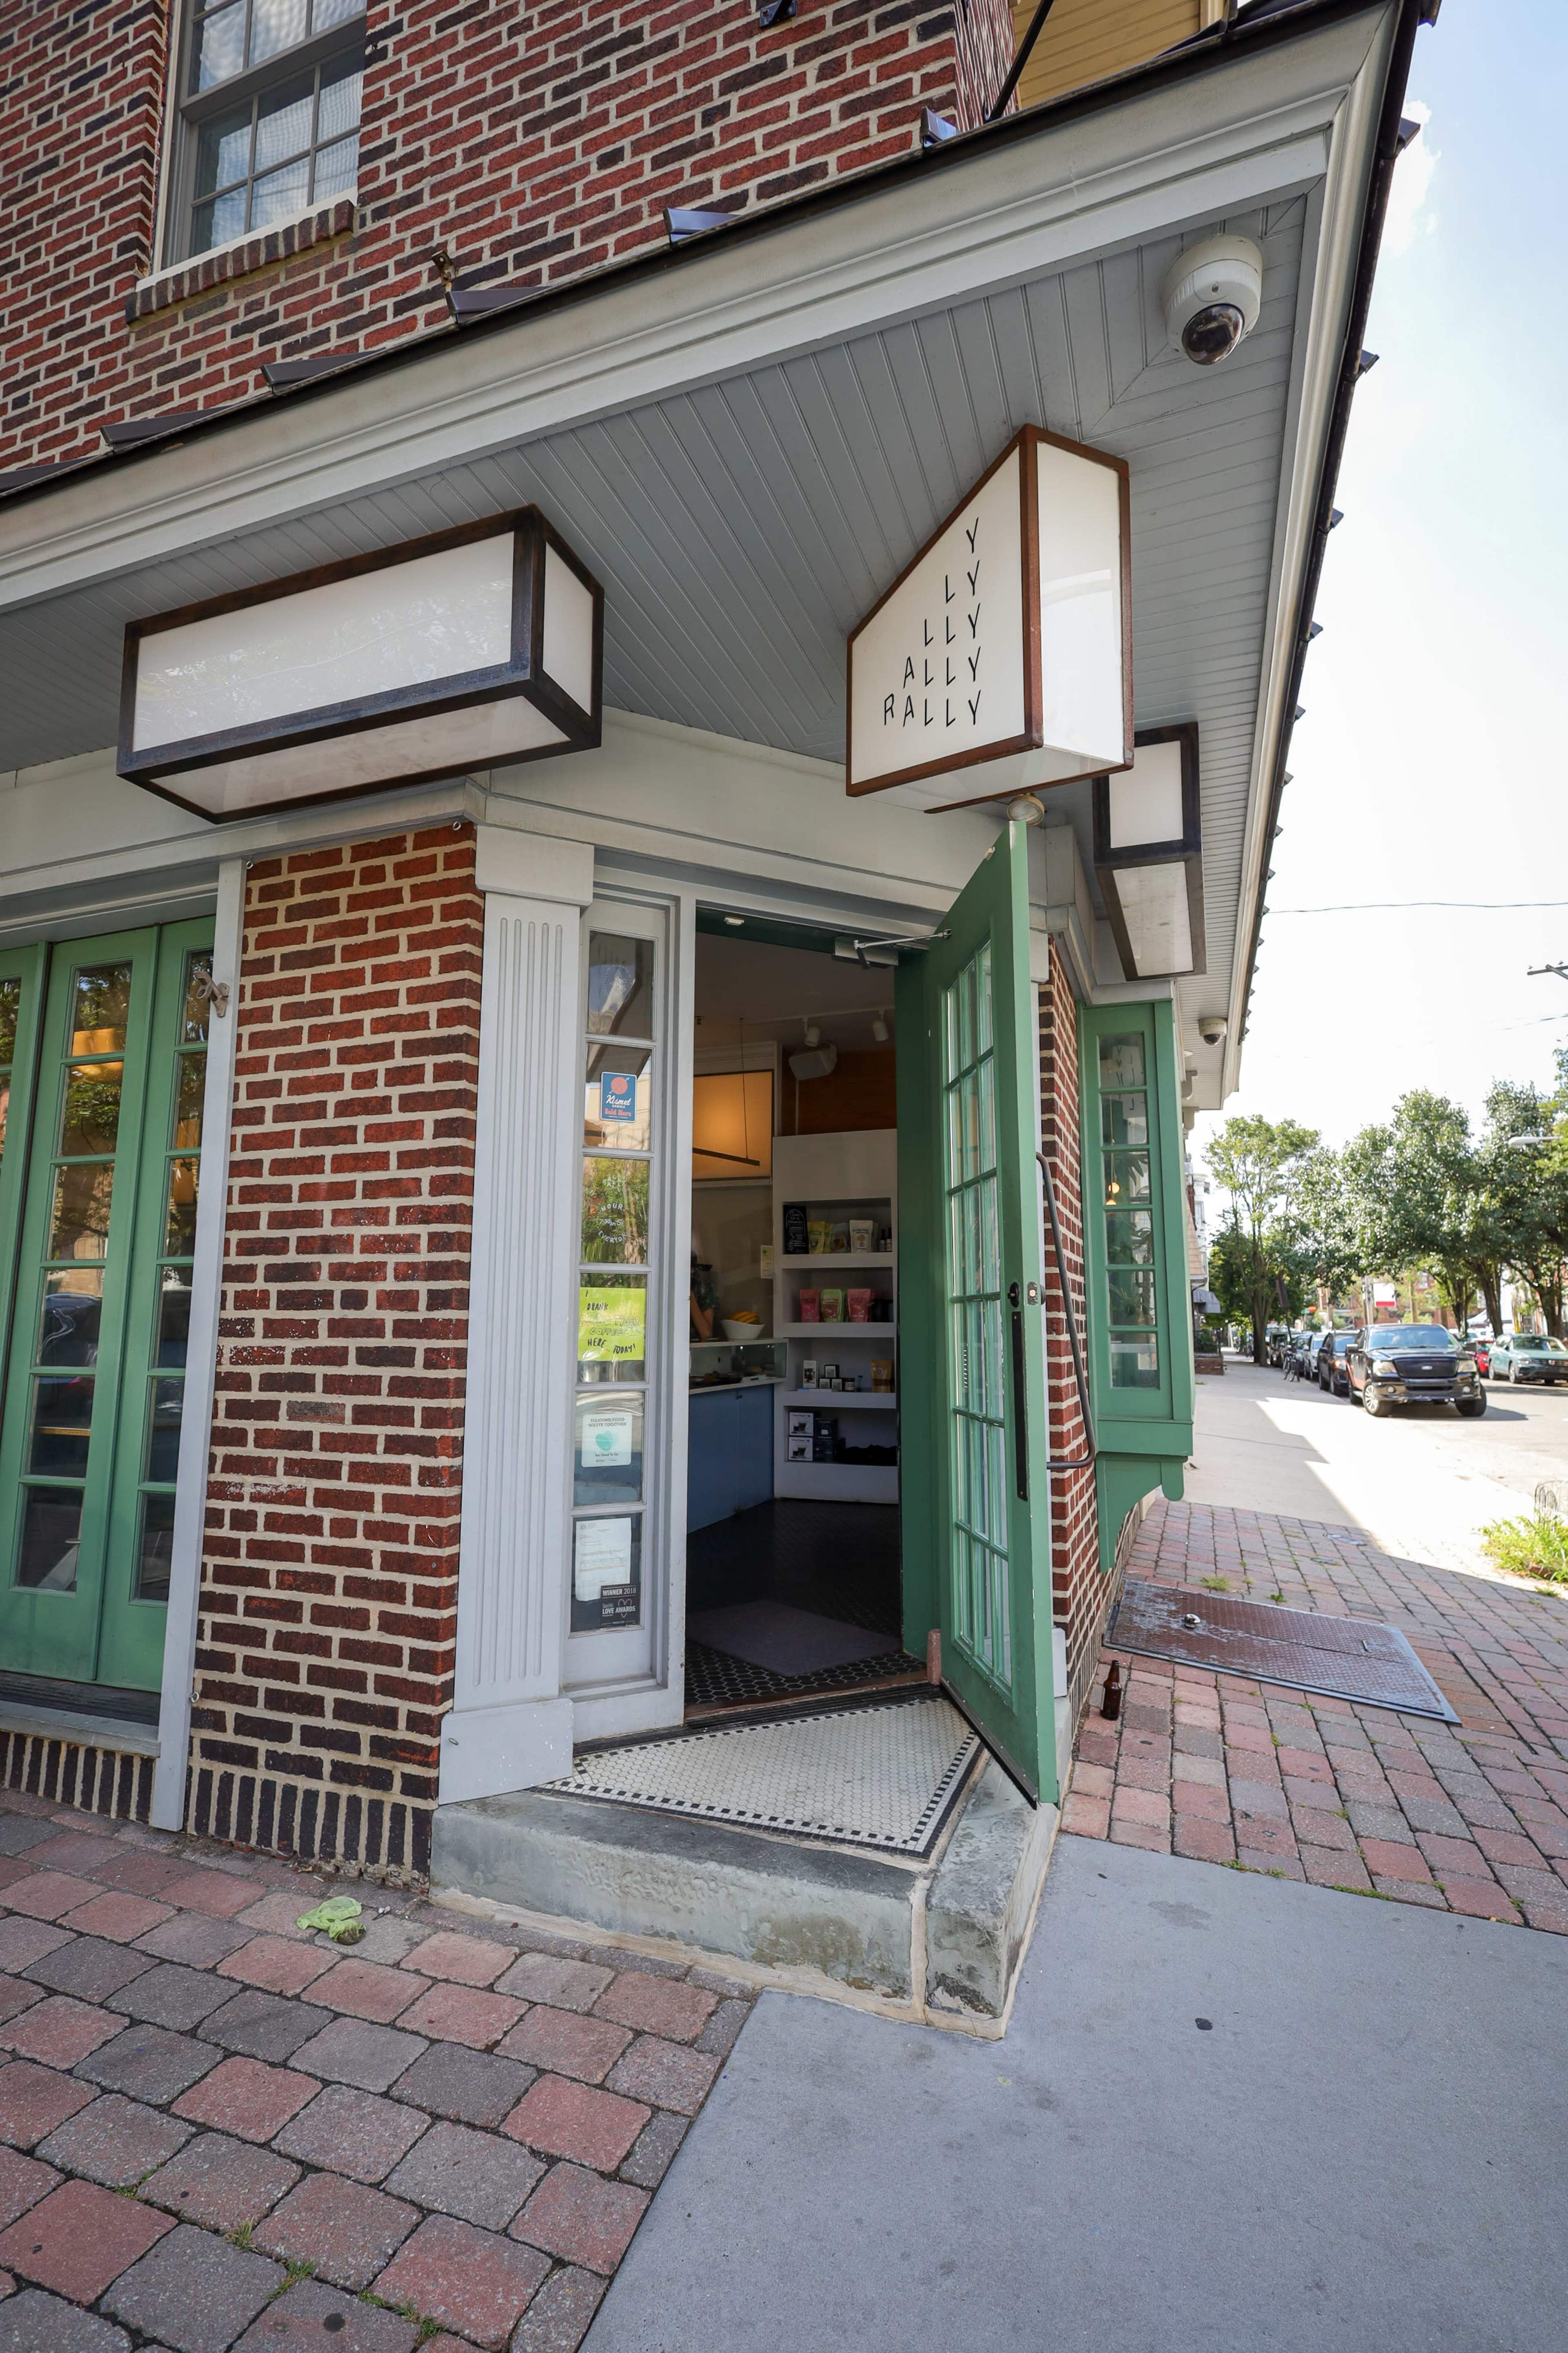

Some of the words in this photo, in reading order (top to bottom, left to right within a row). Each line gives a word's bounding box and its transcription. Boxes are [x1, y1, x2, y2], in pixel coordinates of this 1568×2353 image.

[966, 517, 979, 553] Y
[945, 560, 980, 604] LY
[924, 602, 980, 647] LLY
[903, 646, 981, 689] ALLY
[884, 689, 981, 727] RALLY
[606, 1095, 631, 1106] Kismet
[587, 1303, 608, 1311] DRANK
[613, 1343, 637, 1354] TODAY!
